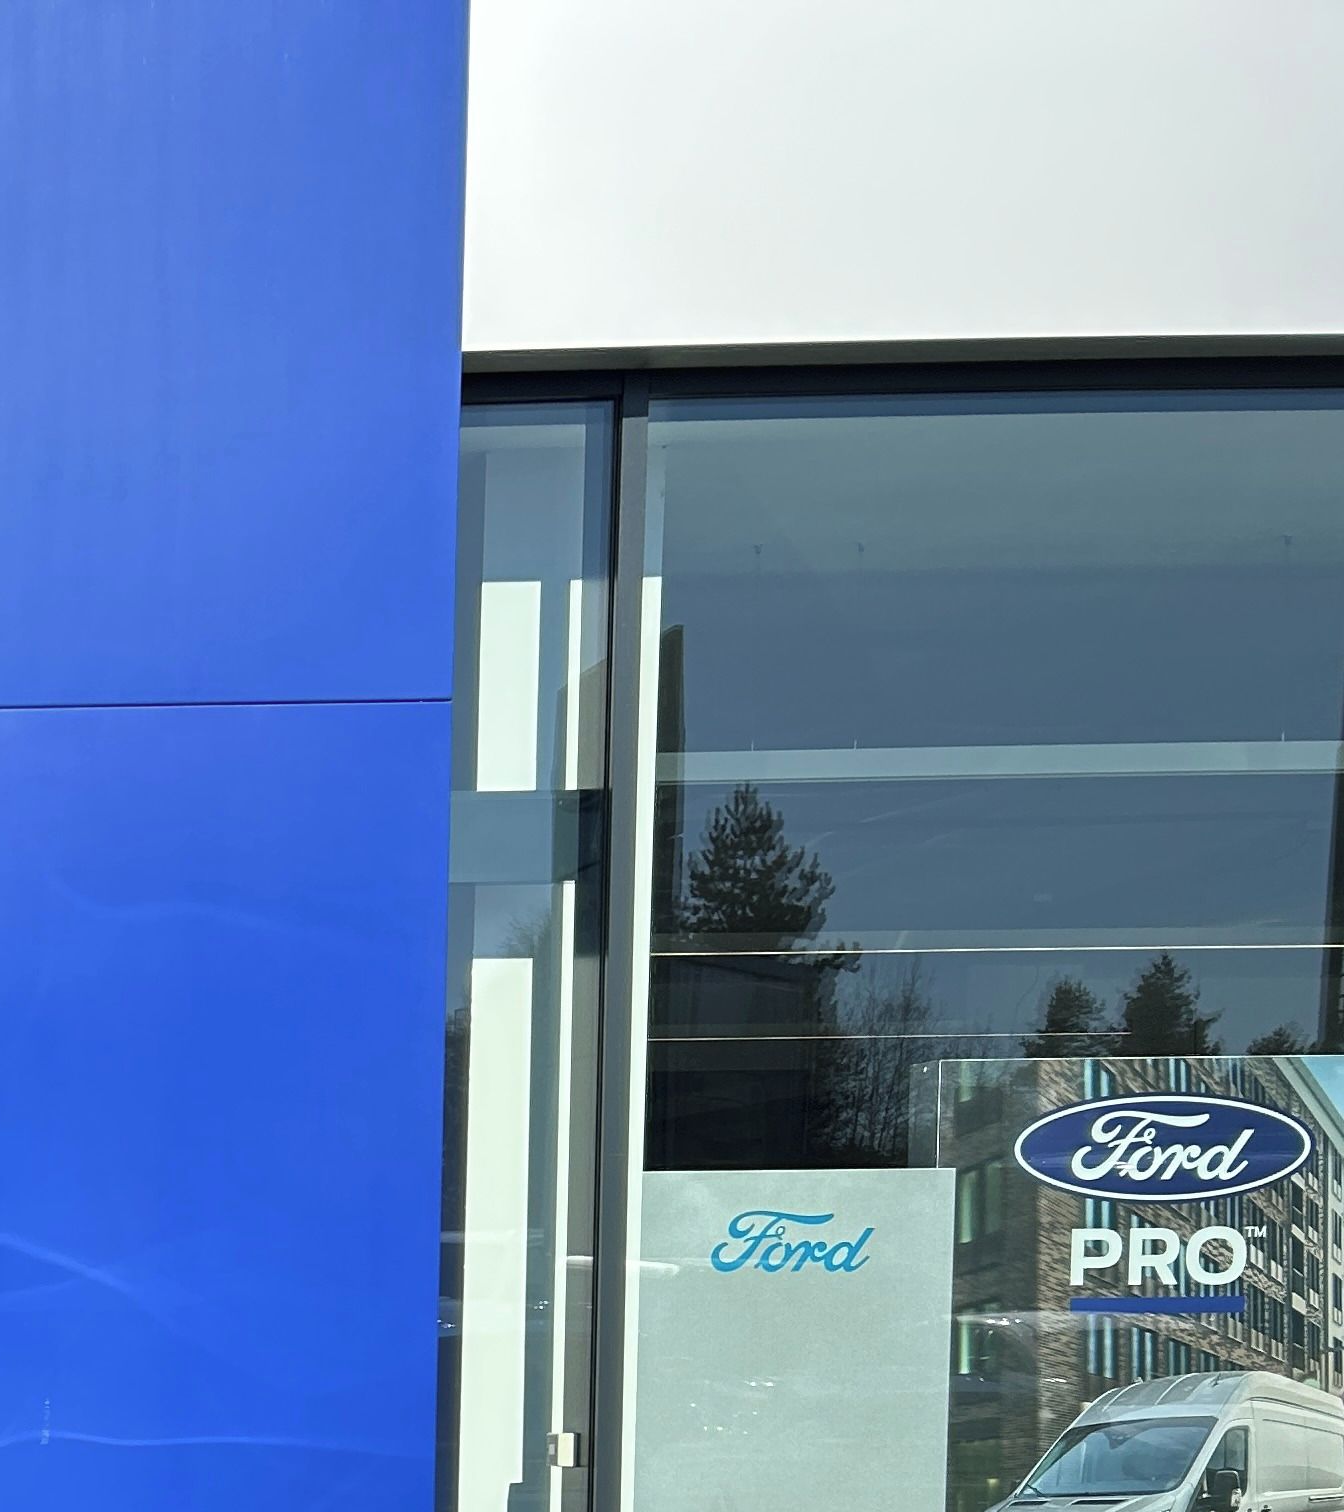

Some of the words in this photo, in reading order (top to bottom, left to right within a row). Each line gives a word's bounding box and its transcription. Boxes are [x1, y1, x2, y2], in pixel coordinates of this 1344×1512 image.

[1070, 1110, 1255, 1181] Ford
[711, 1210, 875, 1272] Ford
[1069, 1225, 1248, 1286] PRO
